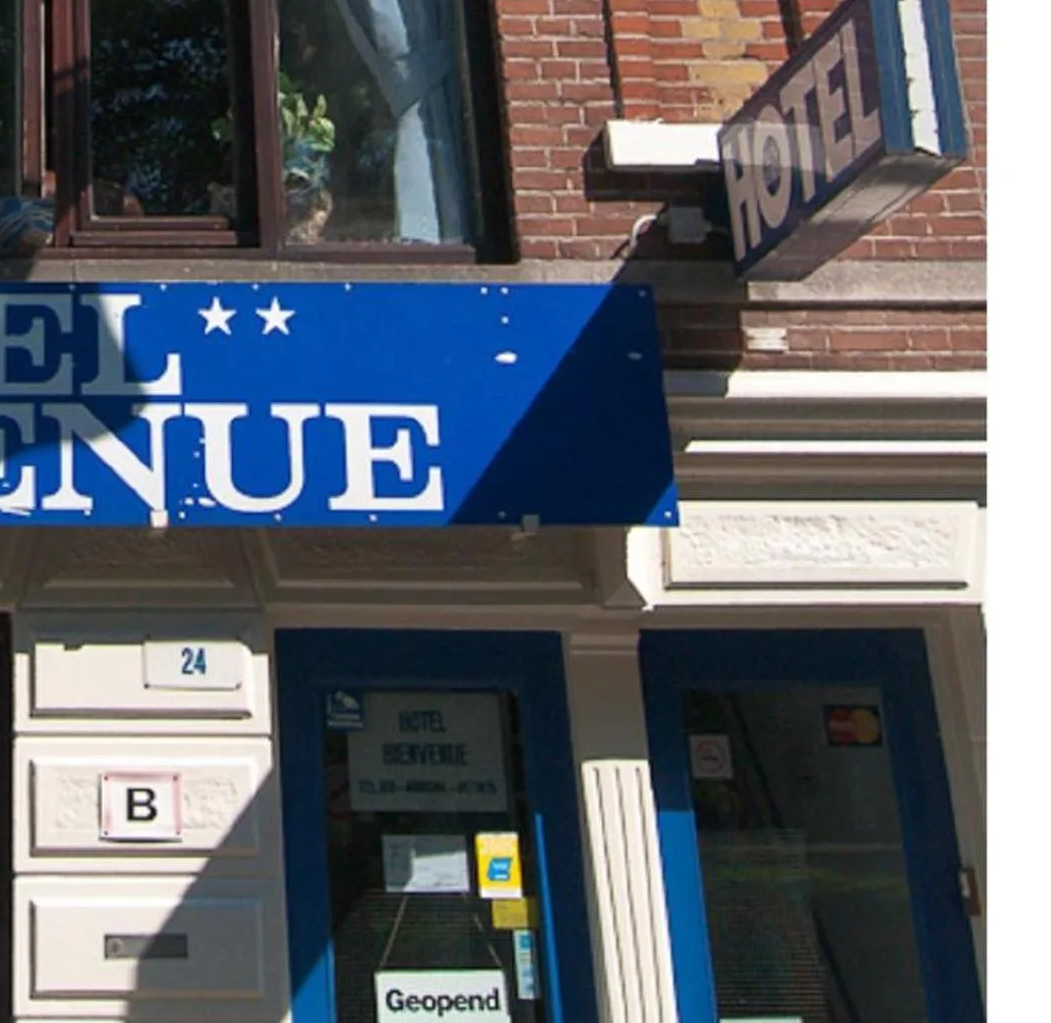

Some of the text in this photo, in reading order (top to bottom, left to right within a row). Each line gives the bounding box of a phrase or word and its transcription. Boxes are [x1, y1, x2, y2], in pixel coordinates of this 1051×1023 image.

[720, 18, 881, 261] HOTEL
[180, 647, 207, 675] 24
[399, 710, 447, 733] HOTEL
[126, 787, 158, 821] B
[385, 987, 501, 1017] Geopend
